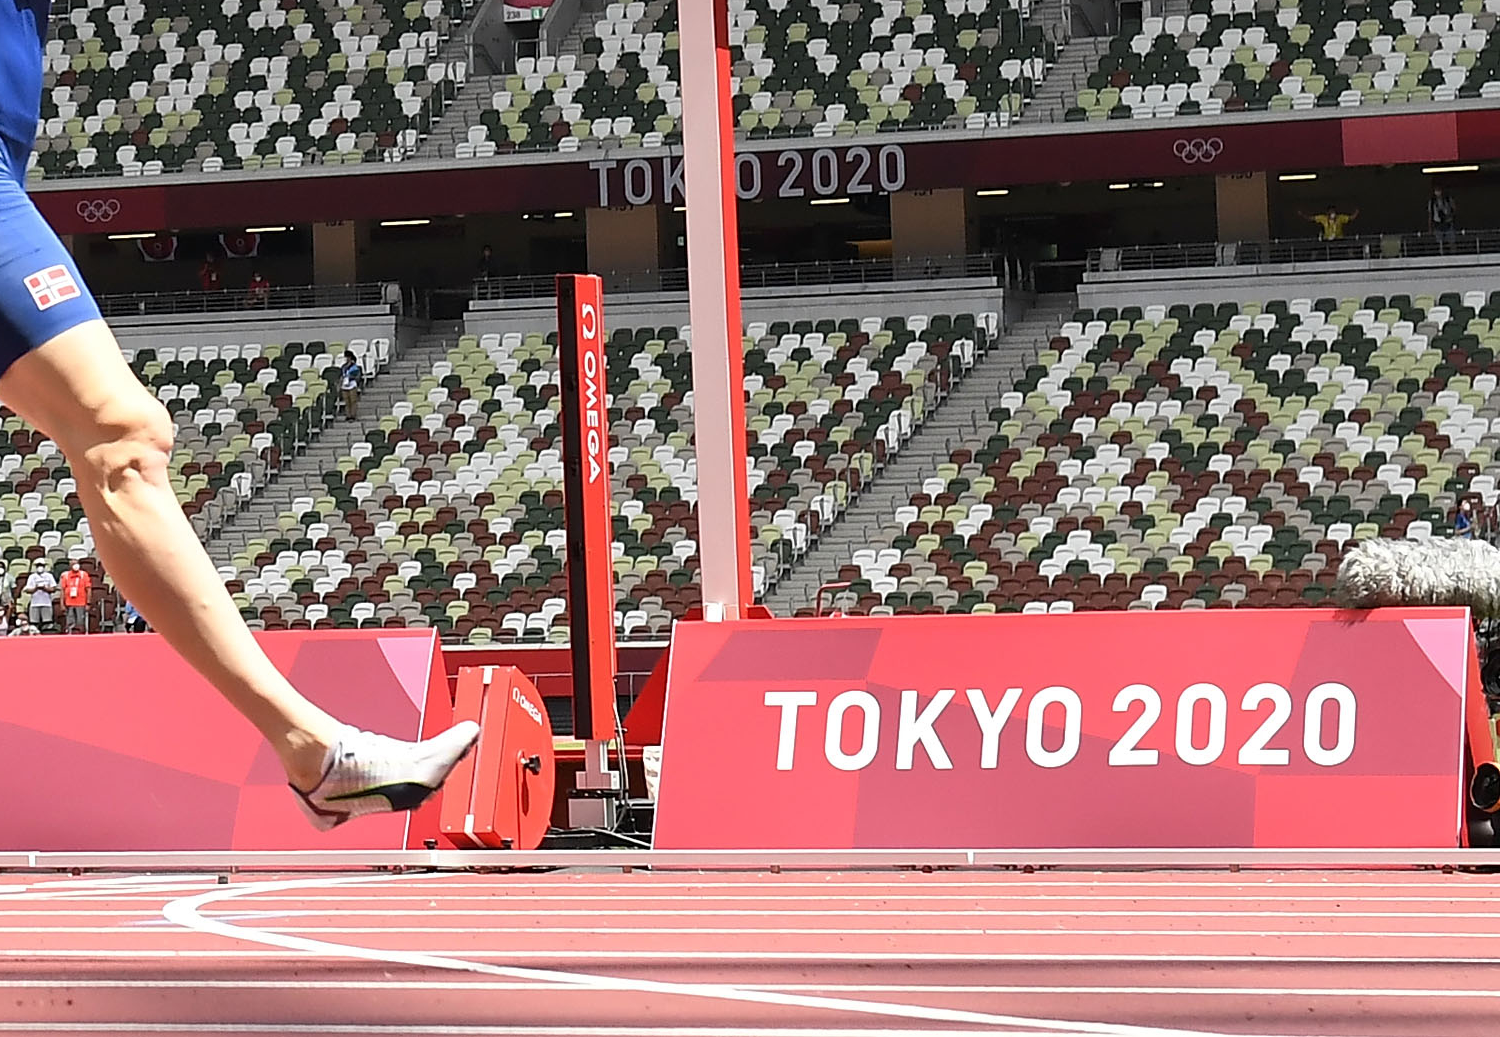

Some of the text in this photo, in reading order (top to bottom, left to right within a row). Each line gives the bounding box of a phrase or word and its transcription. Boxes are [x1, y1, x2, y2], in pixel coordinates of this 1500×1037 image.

[589, 144, 906, 207] TOKO 2020
[584, 351, 601, 483] OMEGA
[764, 681, 1357, 771] TOKYO 2020
